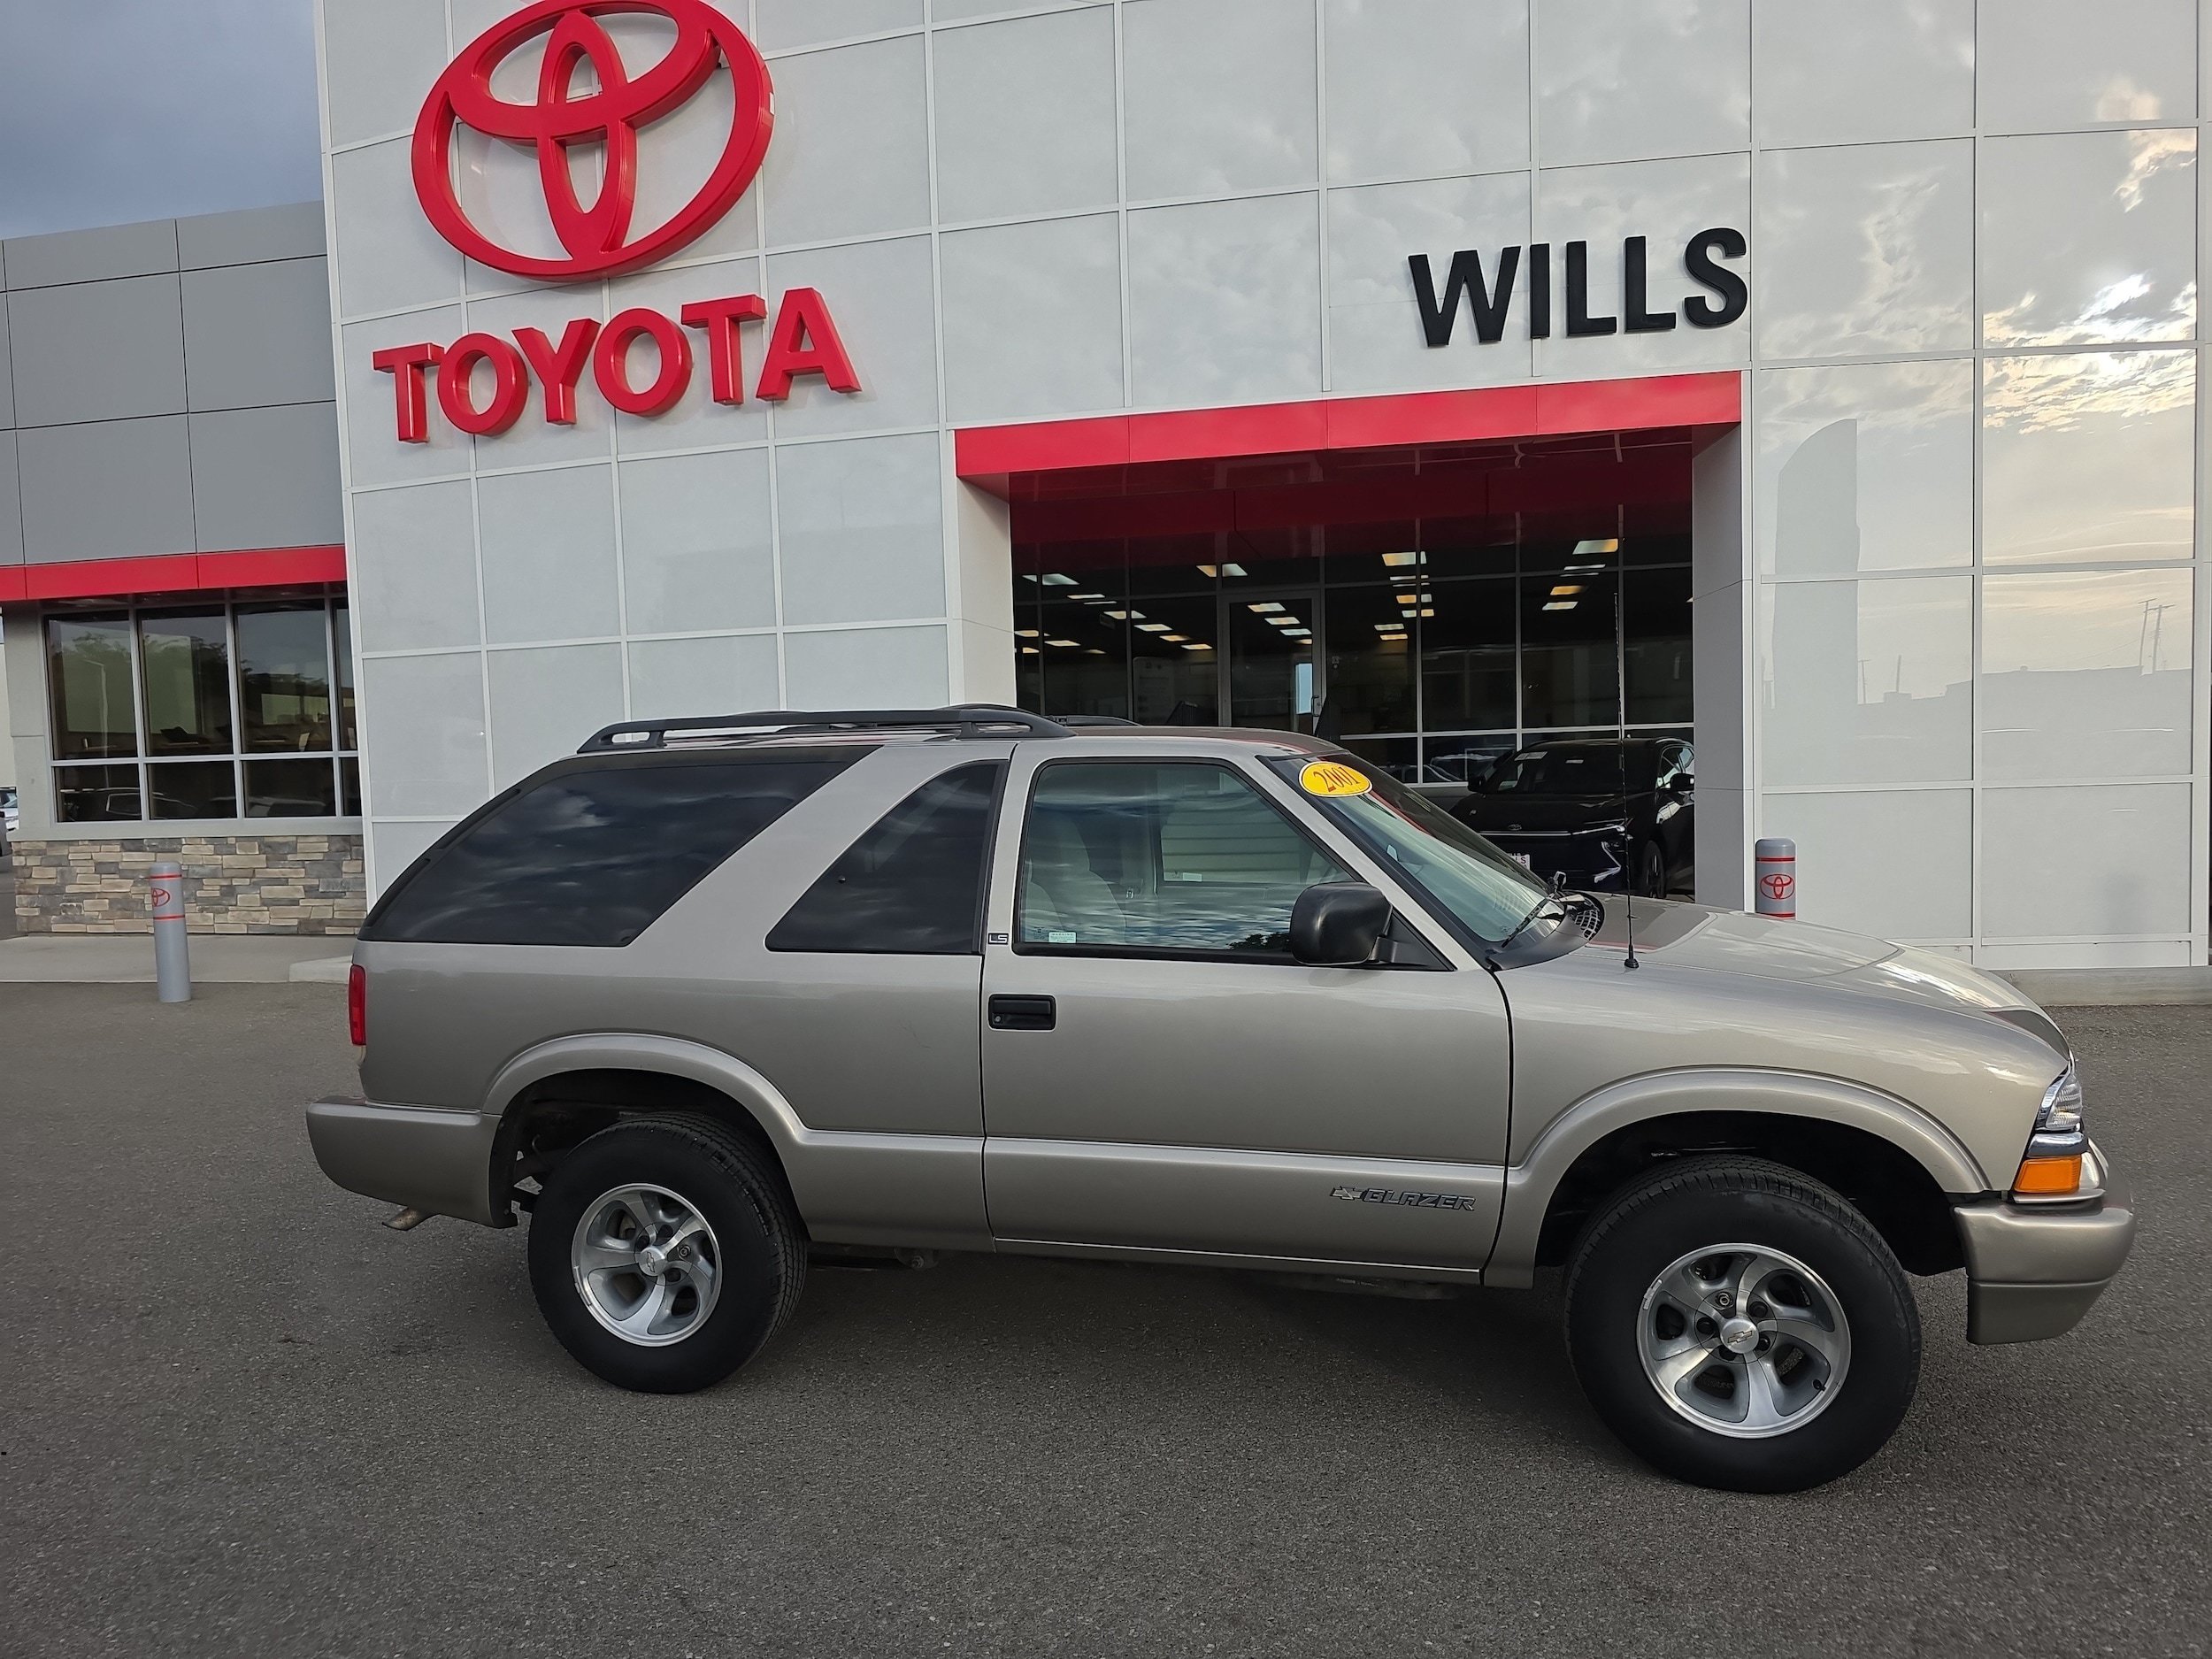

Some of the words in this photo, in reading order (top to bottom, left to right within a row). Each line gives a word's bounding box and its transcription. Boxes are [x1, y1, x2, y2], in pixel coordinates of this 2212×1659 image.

[1408, 227, 1747, 347] WILLS
[373, 288, 862, 442] TOYOTA
[1313, 766, 1361, 793] 2001
[988, 933, 1009, 944] LS
[1363, 1188, 1477, 1211] BLAZER
